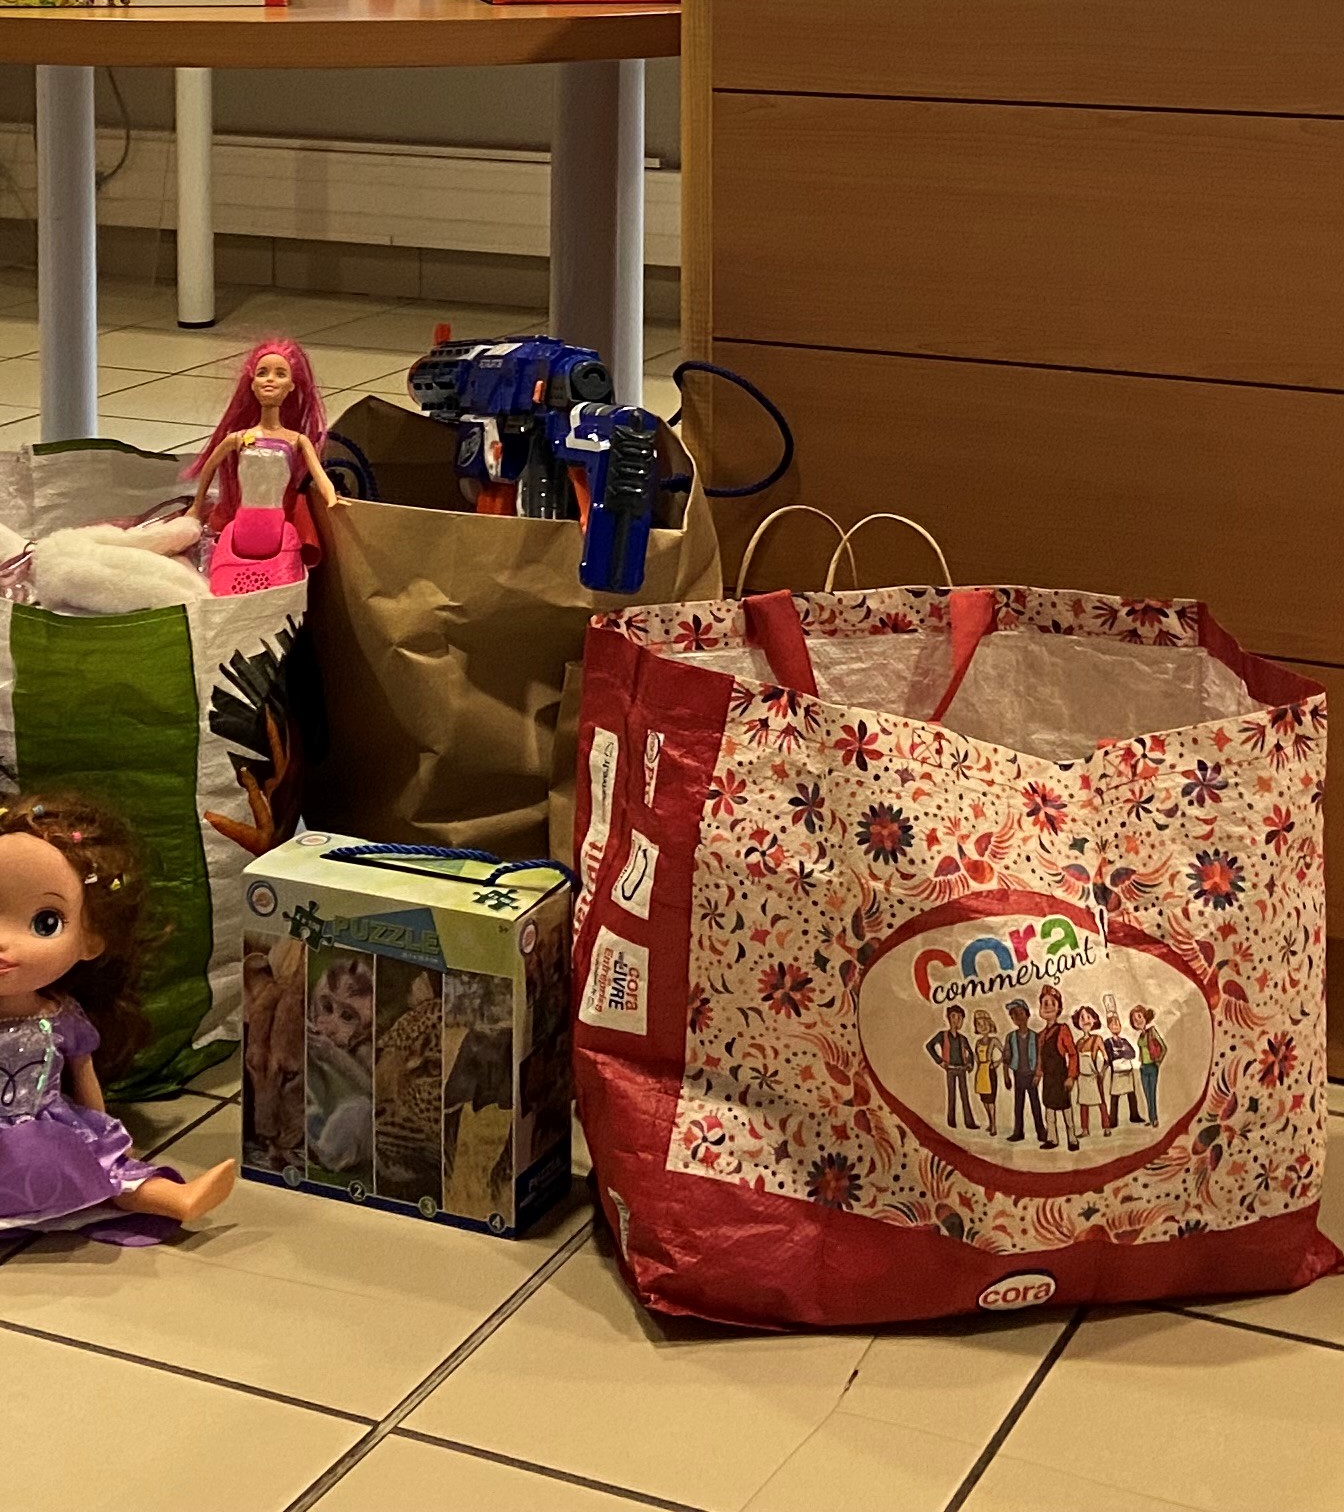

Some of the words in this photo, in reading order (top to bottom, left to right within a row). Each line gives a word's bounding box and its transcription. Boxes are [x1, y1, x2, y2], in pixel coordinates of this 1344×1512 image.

[332, 915, 441, 955] PUZZLE
[913, 916, 1080, 1002] cora
[932, 936, 1097, 1005] commerçant
[609, 959, 628, 1010] LIVRE
[626, 967, 640, 1011] cora
[982, 1283, 1051, 1305] cora
